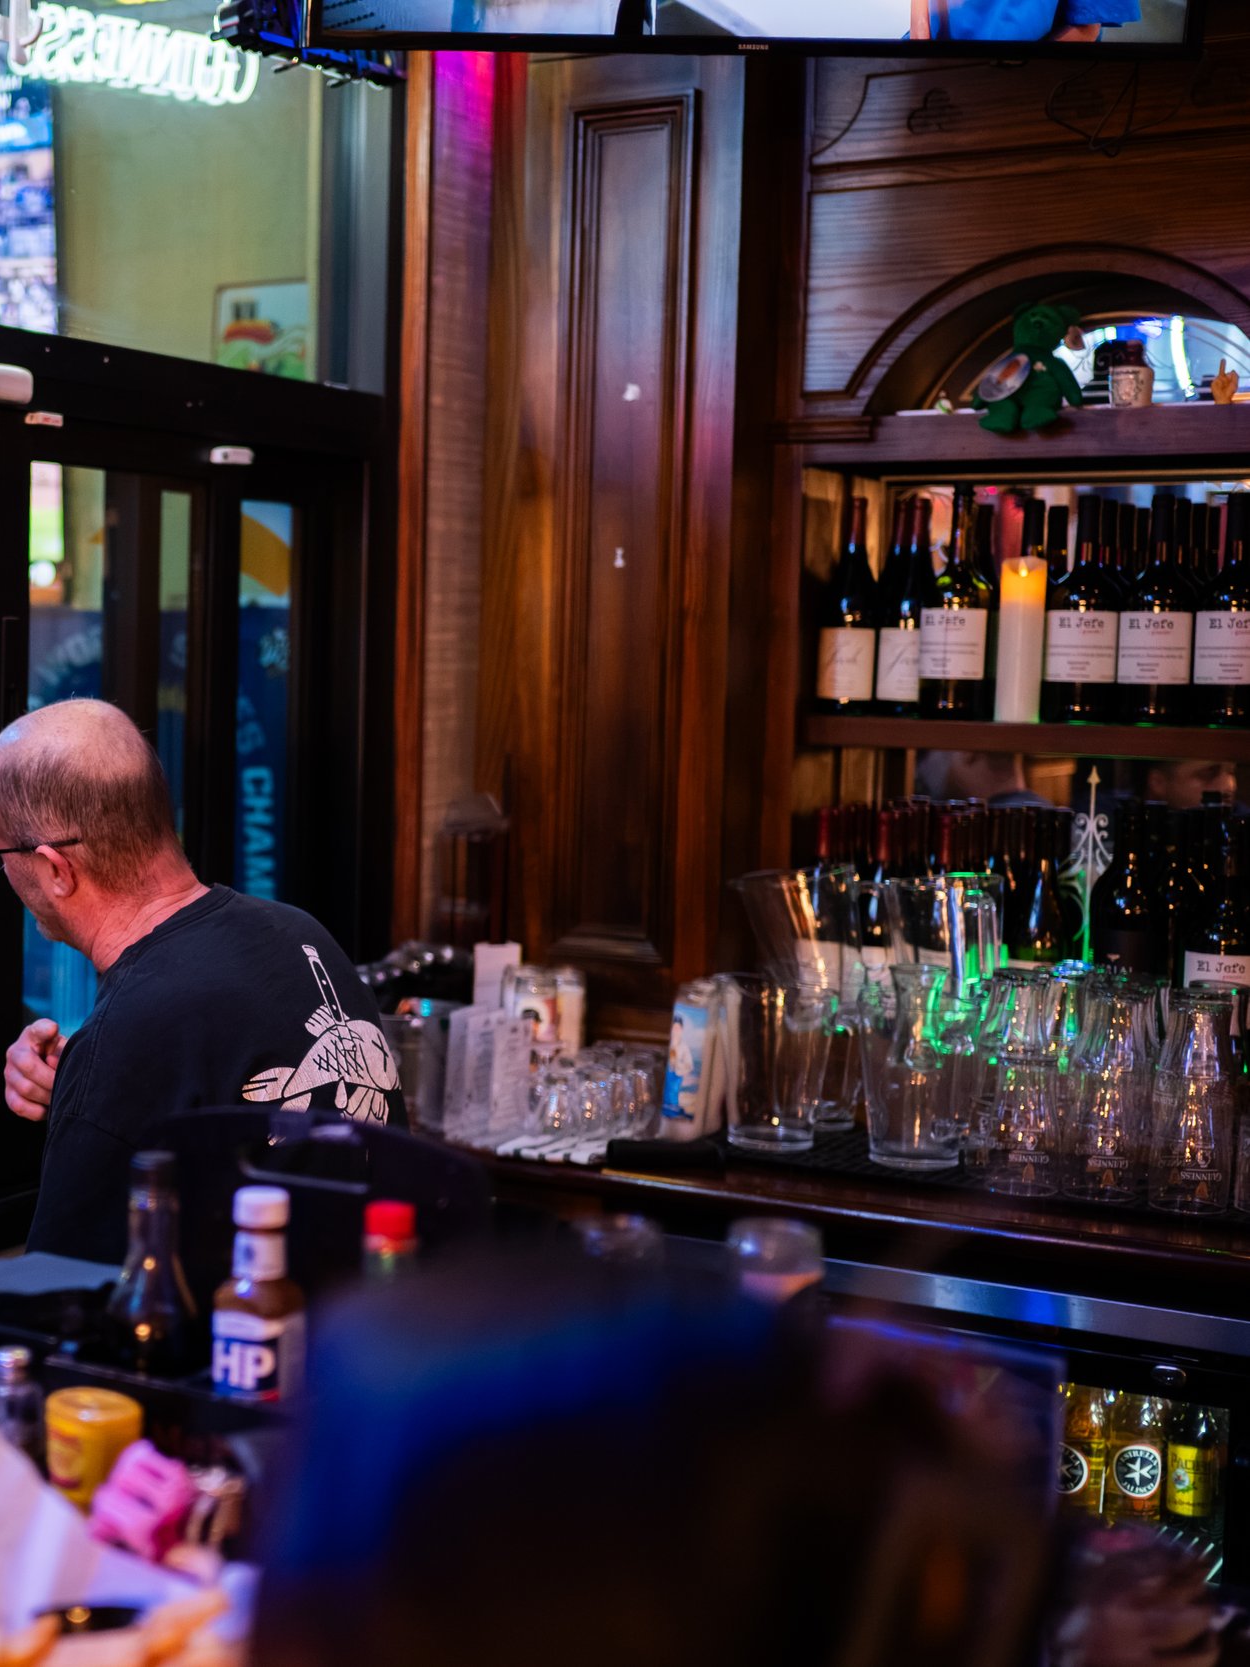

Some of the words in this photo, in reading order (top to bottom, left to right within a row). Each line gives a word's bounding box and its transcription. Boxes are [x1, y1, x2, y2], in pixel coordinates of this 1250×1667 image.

[737, 43, 770, 51] SAMSUNG
[1058, 616, 1072, 629] El
[1075, 617, 1105, 630] Jefe
[1128, 618, 1141, 630] El
[1144, 618, 1175, 631] Jefe
[1208, 617, 1223, 630] El
[1227, 617, 1250, 631] Jef
[240, 766, 277, 902] CHAM
[1196, 959, 1211, 973] El
[1215, 961, 1246, 975] Jefe
[1008, 1153, 1050, 1165] GUINNESS
[1087, 1157, 1129, 1170] GUINNESS
[1180, 1170, 1222, 1183] GUINNESS
[212, 1340, 276, 1391] HP
[1119, 1449, 1158, 1466] ESTRELLA
[1120, 1480, 1156, 1494] JALISCO
